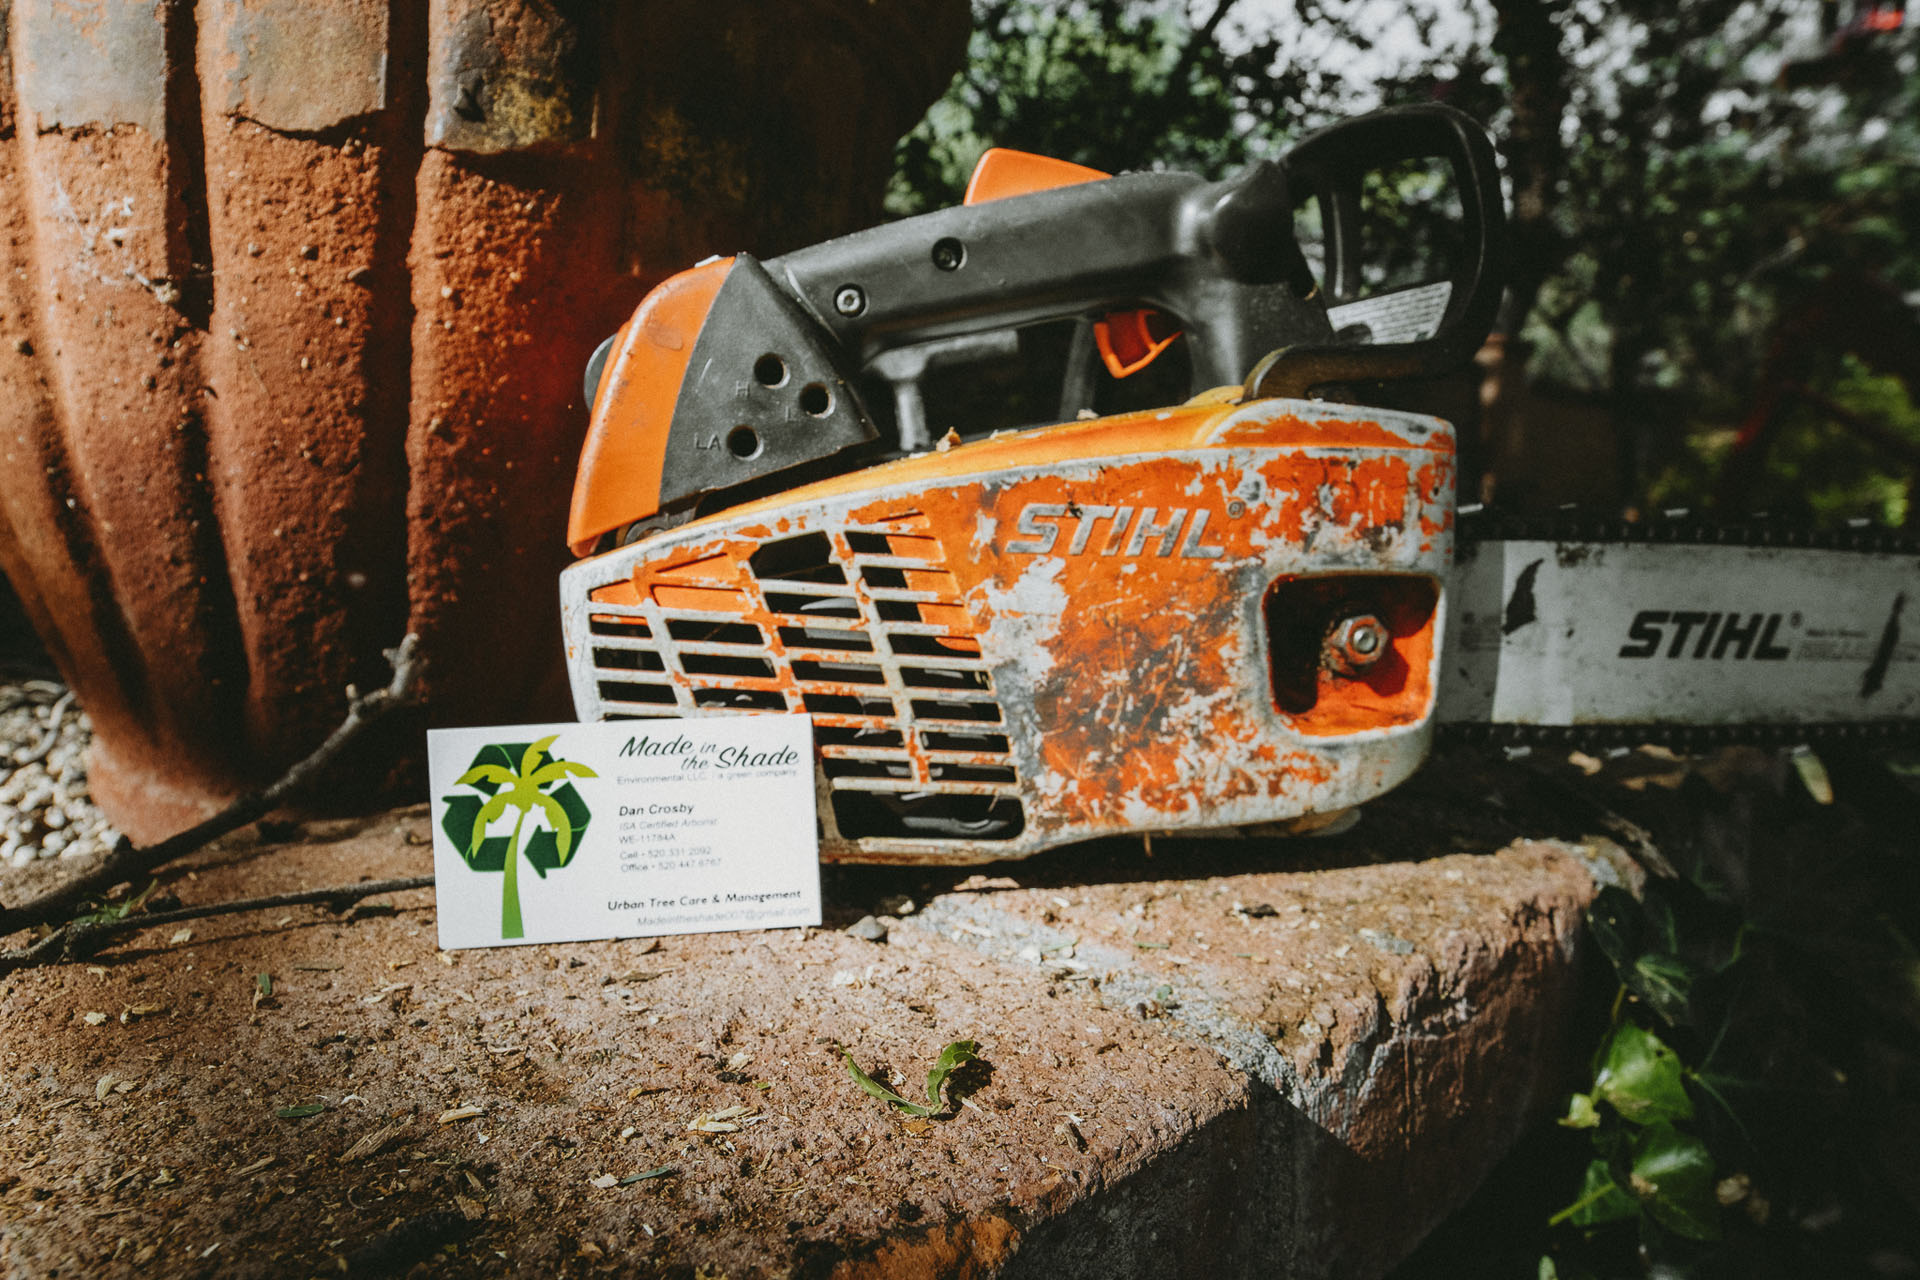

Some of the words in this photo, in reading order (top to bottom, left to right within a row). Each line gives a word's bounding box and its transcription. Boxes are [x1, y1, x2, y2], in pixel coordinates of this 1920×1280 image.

[735, 381, 751, 398] H
[694, 434, 721, 451] LA
[618, 734, 694, 757] Made
[700, 741, 718, 754] in
[680, 754, 709, 771] the
[714, 745, 799, 769] Shade
[616, 773, 684, 786] Environmental
[728, 771, 753, 782] green
[618, 805, 645, 817] Dan
[648, 803, 695, 816] Crosby
[619, 821, 636, 831] ISA
[639, 819, 679, 831] Certified
[681, 818, 720, 828] Arborist
[647, 849, 666, 859] 520
[620, 861, 649, 873] Office
[658, 860, 676, 871] 520
[607, 900, 645, 911] Urban
[650, 898, 676, 909] Tree
[679, 895, 708, 906] Care
[711, 893, 721, 904] &
[724, 889, 802, 903] Management
